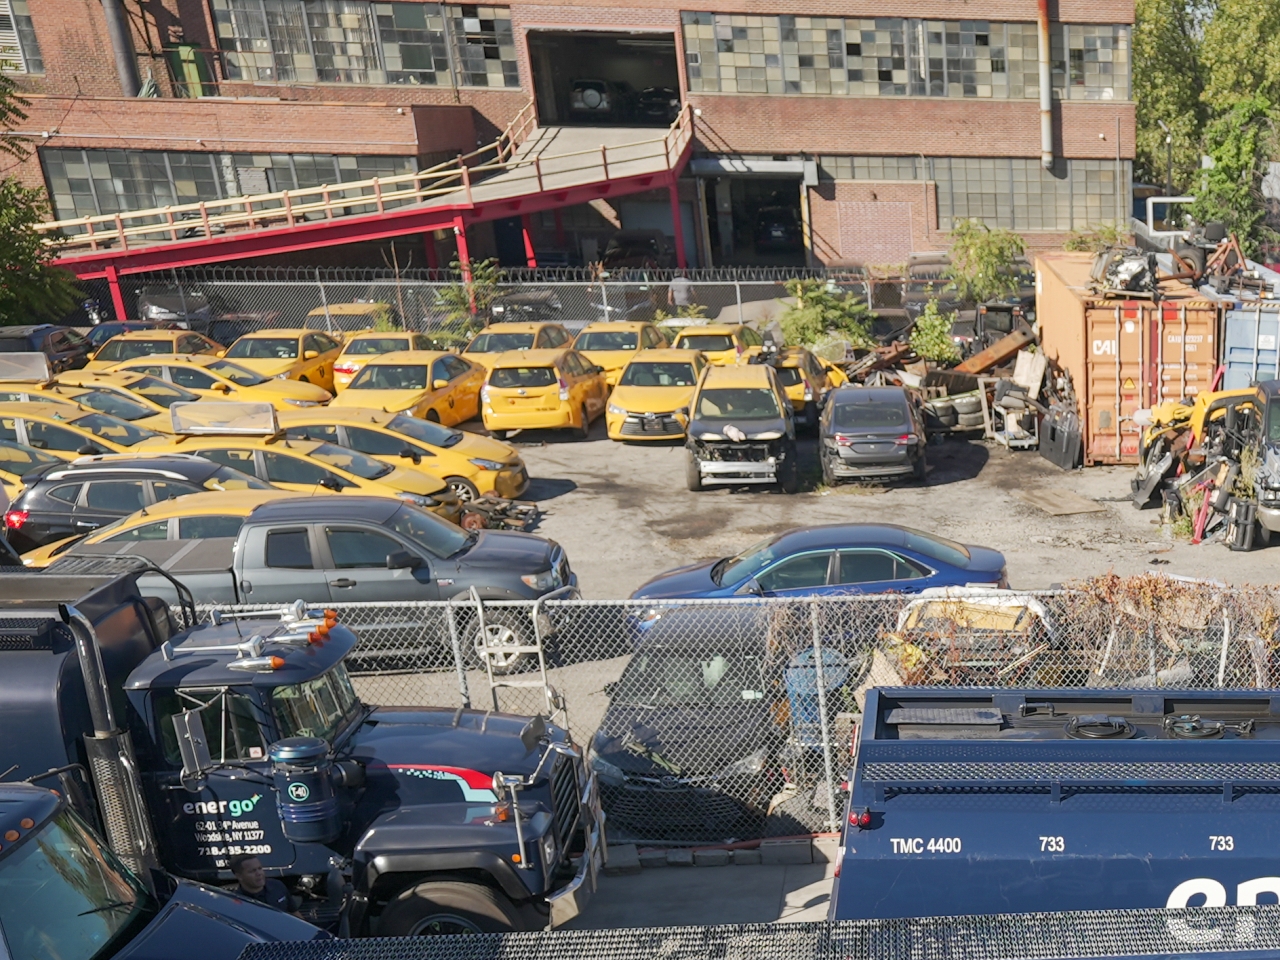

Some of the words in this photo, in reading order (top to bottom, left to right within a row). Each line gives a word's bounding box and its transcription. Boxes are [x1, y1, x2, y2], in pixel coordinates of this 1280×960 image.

[183, 799, 254, 817] energo
[195, 821, 217, 831] 62-01
[232, 820, 259, 830] Avenue
[194, 831, 233, 842] Woodside,
[232, 831, 243, 840] NY
[244, 830, 264, 840] 11377
[1209, 836, 1234, 850] 733
[198, 844, 272, 856] 718.435.2200
[890, 838, 924, 854] TMC
[926, 837, 962, 853] 4400
[1039, 837, 1065, 851] 733
